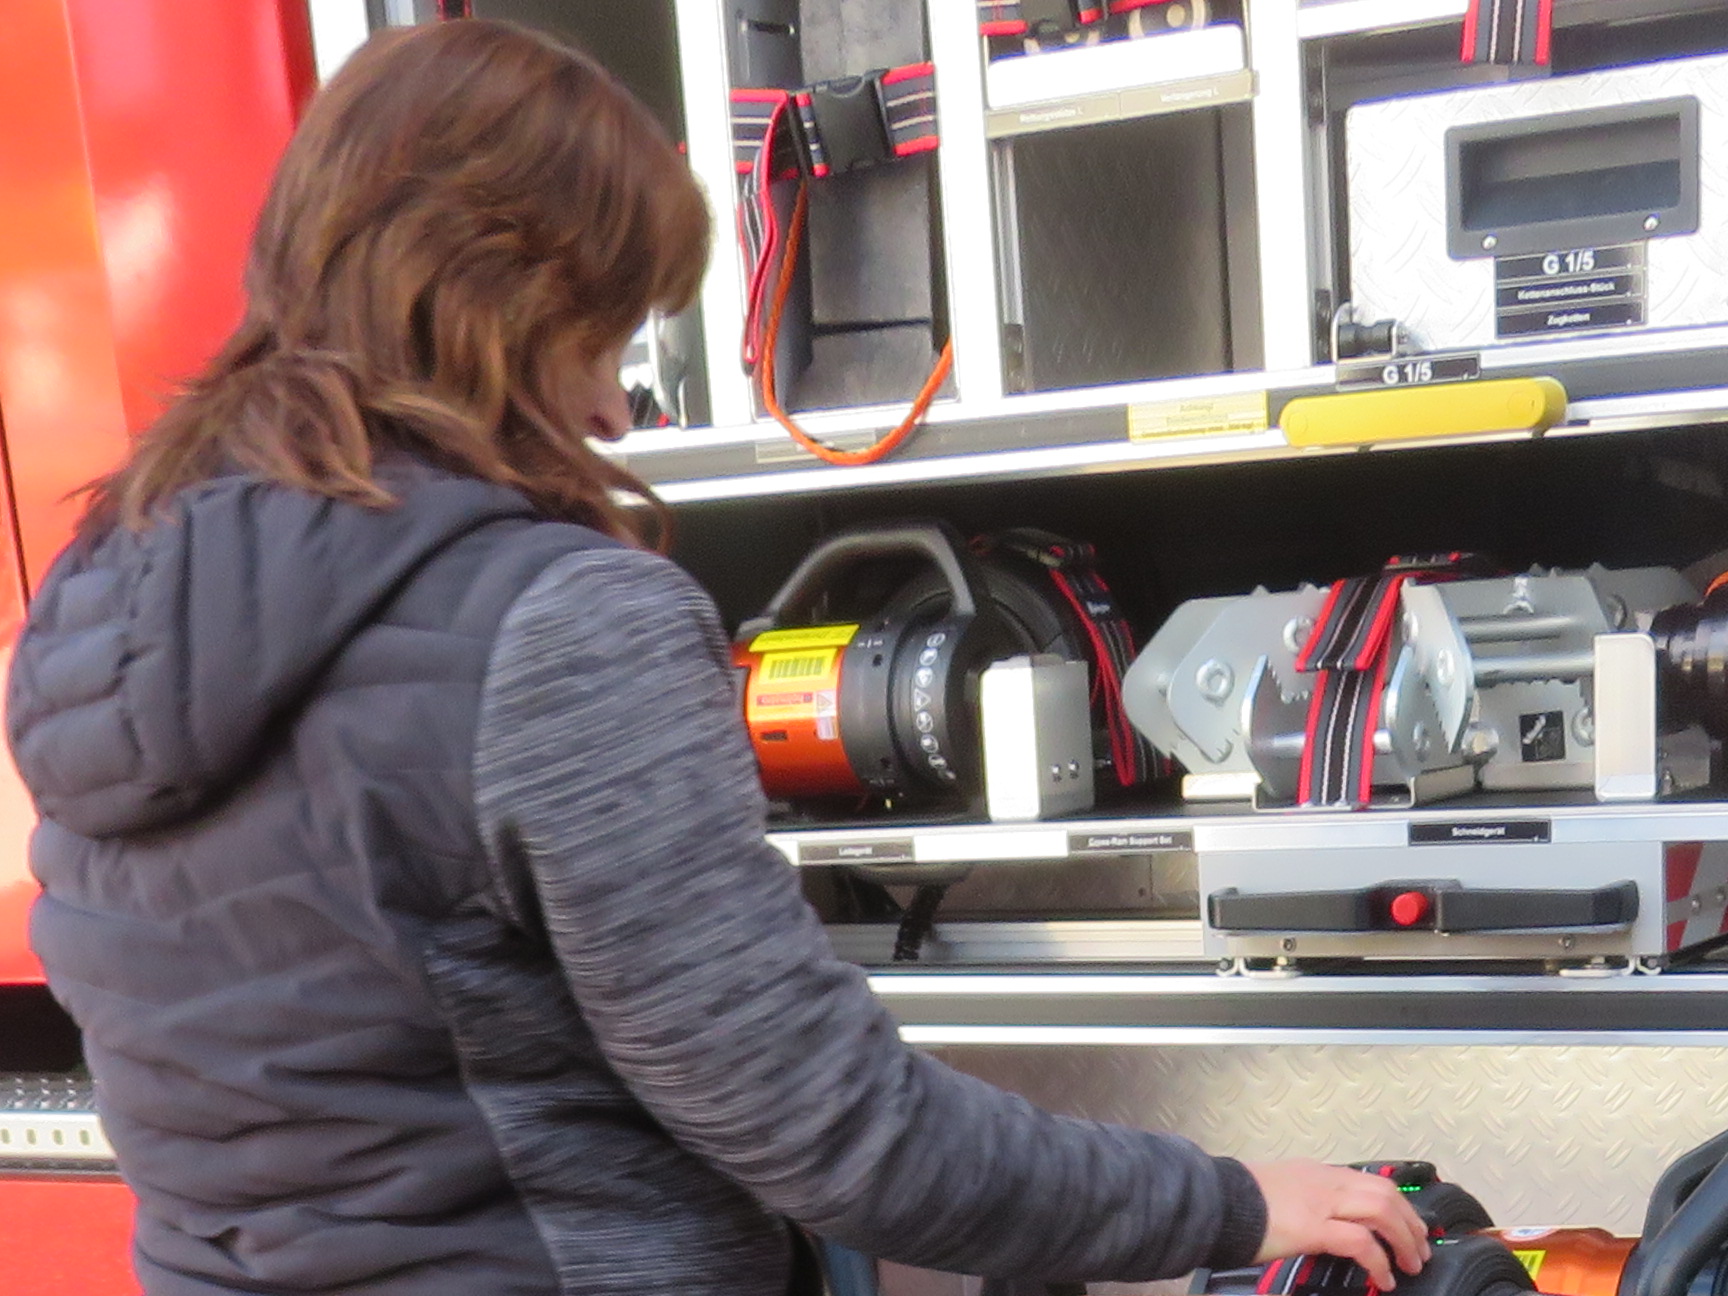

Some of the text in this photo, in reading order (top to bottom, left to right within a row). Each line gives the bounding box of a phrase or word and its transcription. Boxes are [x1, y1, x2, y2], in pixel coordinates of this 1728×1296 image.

[1542, 250, 1595, 275] G 1/5
[1382, 361, 1433, 385] G 1/5
